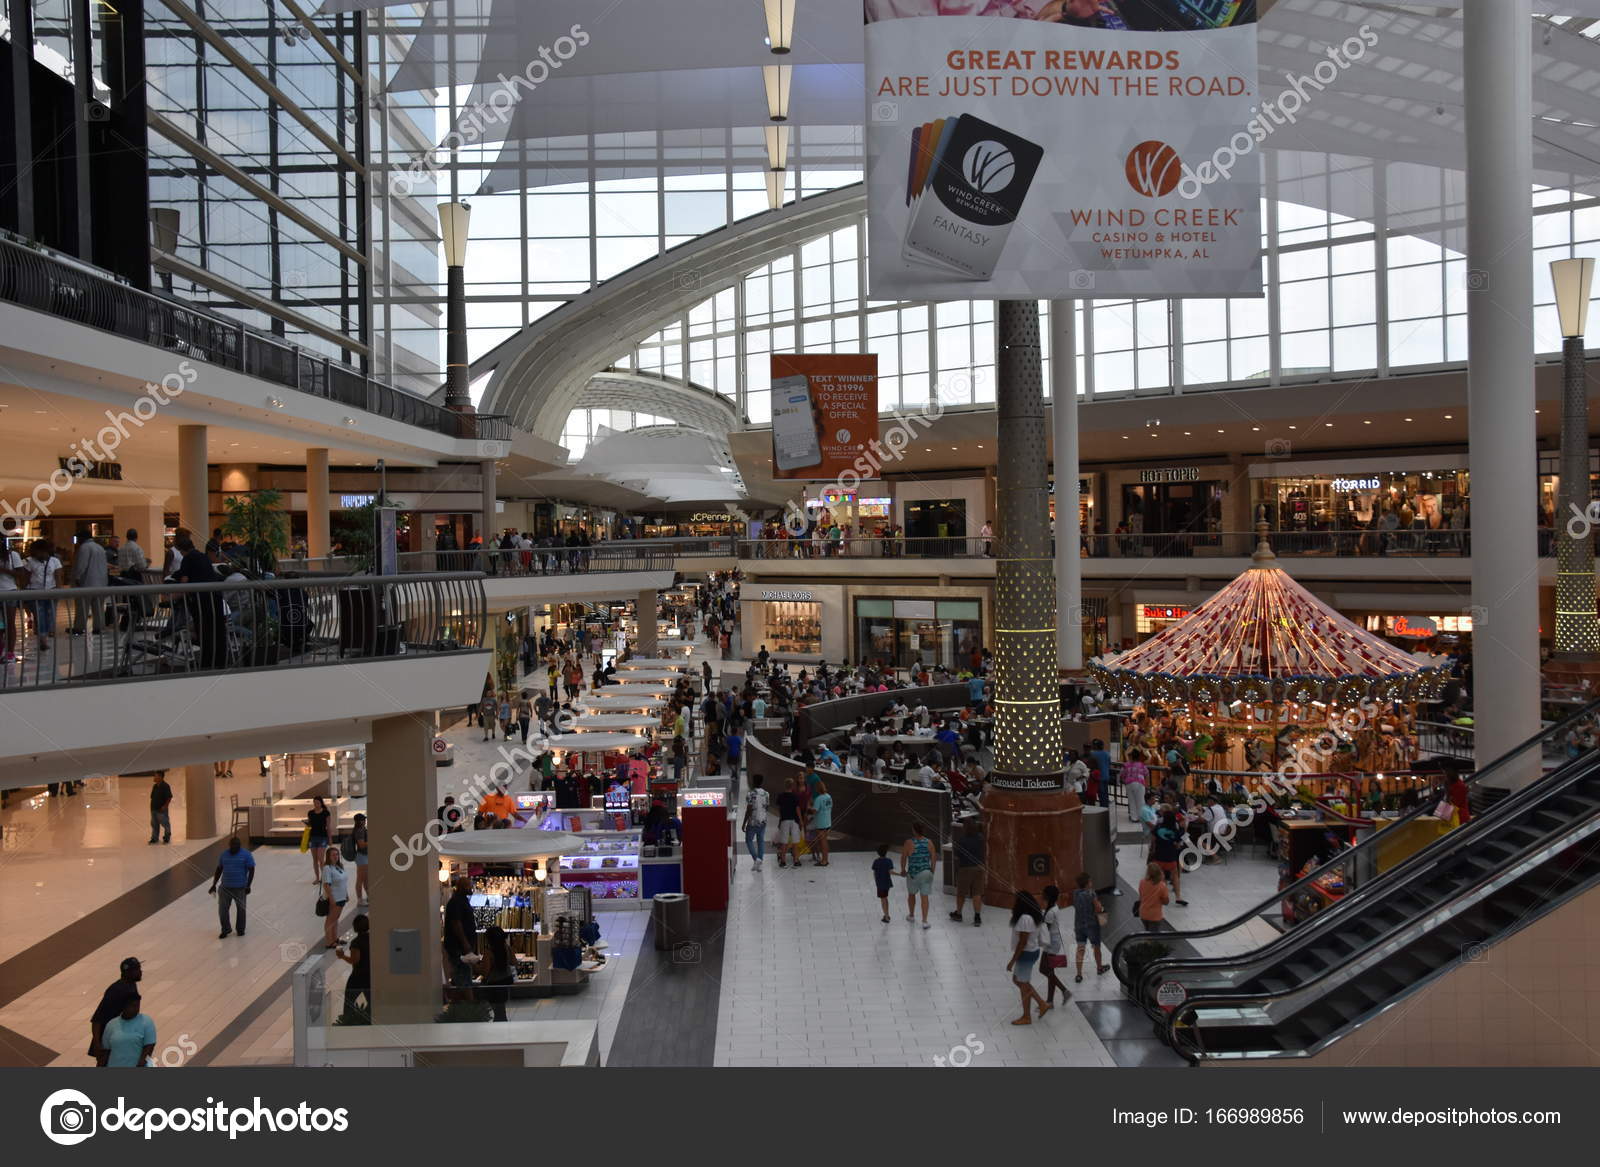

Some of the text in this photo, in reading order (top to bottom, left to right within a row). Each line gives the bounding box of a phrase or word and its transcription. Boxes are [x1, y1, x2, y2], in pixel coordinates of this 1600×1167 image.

[946, 49, 1180, 70] GREAT REWARDS
[877, 76, 1251, 97] ARE JUST DOWN THE ROAD.
[947, 184, 1002, 214] WIND CREEK
[1070, 208, 1146, 227] WIND
[932, 215, 990, 247] FANTASY
[1092, 231, 1217, 243] CASINO & HOTEL
[1100, 247, 1209, 260] WETUMPKA, AL
[810, 375, 833, 383] TEXT
[821, 384, 865, 392] TO 31996
[818, 392, 869, 401] TO RECEIVE
[822, 401, 867, 410] A SPECIAL
[1165, 467, 1200, 481] TOPIC
[1333, 479, 1381, 490] TORRID
[690, 512, 731, 522] JCPenney
[1143, 607, 1167, 617] Suki
[1025, 777, 1056, 788] Tokens
